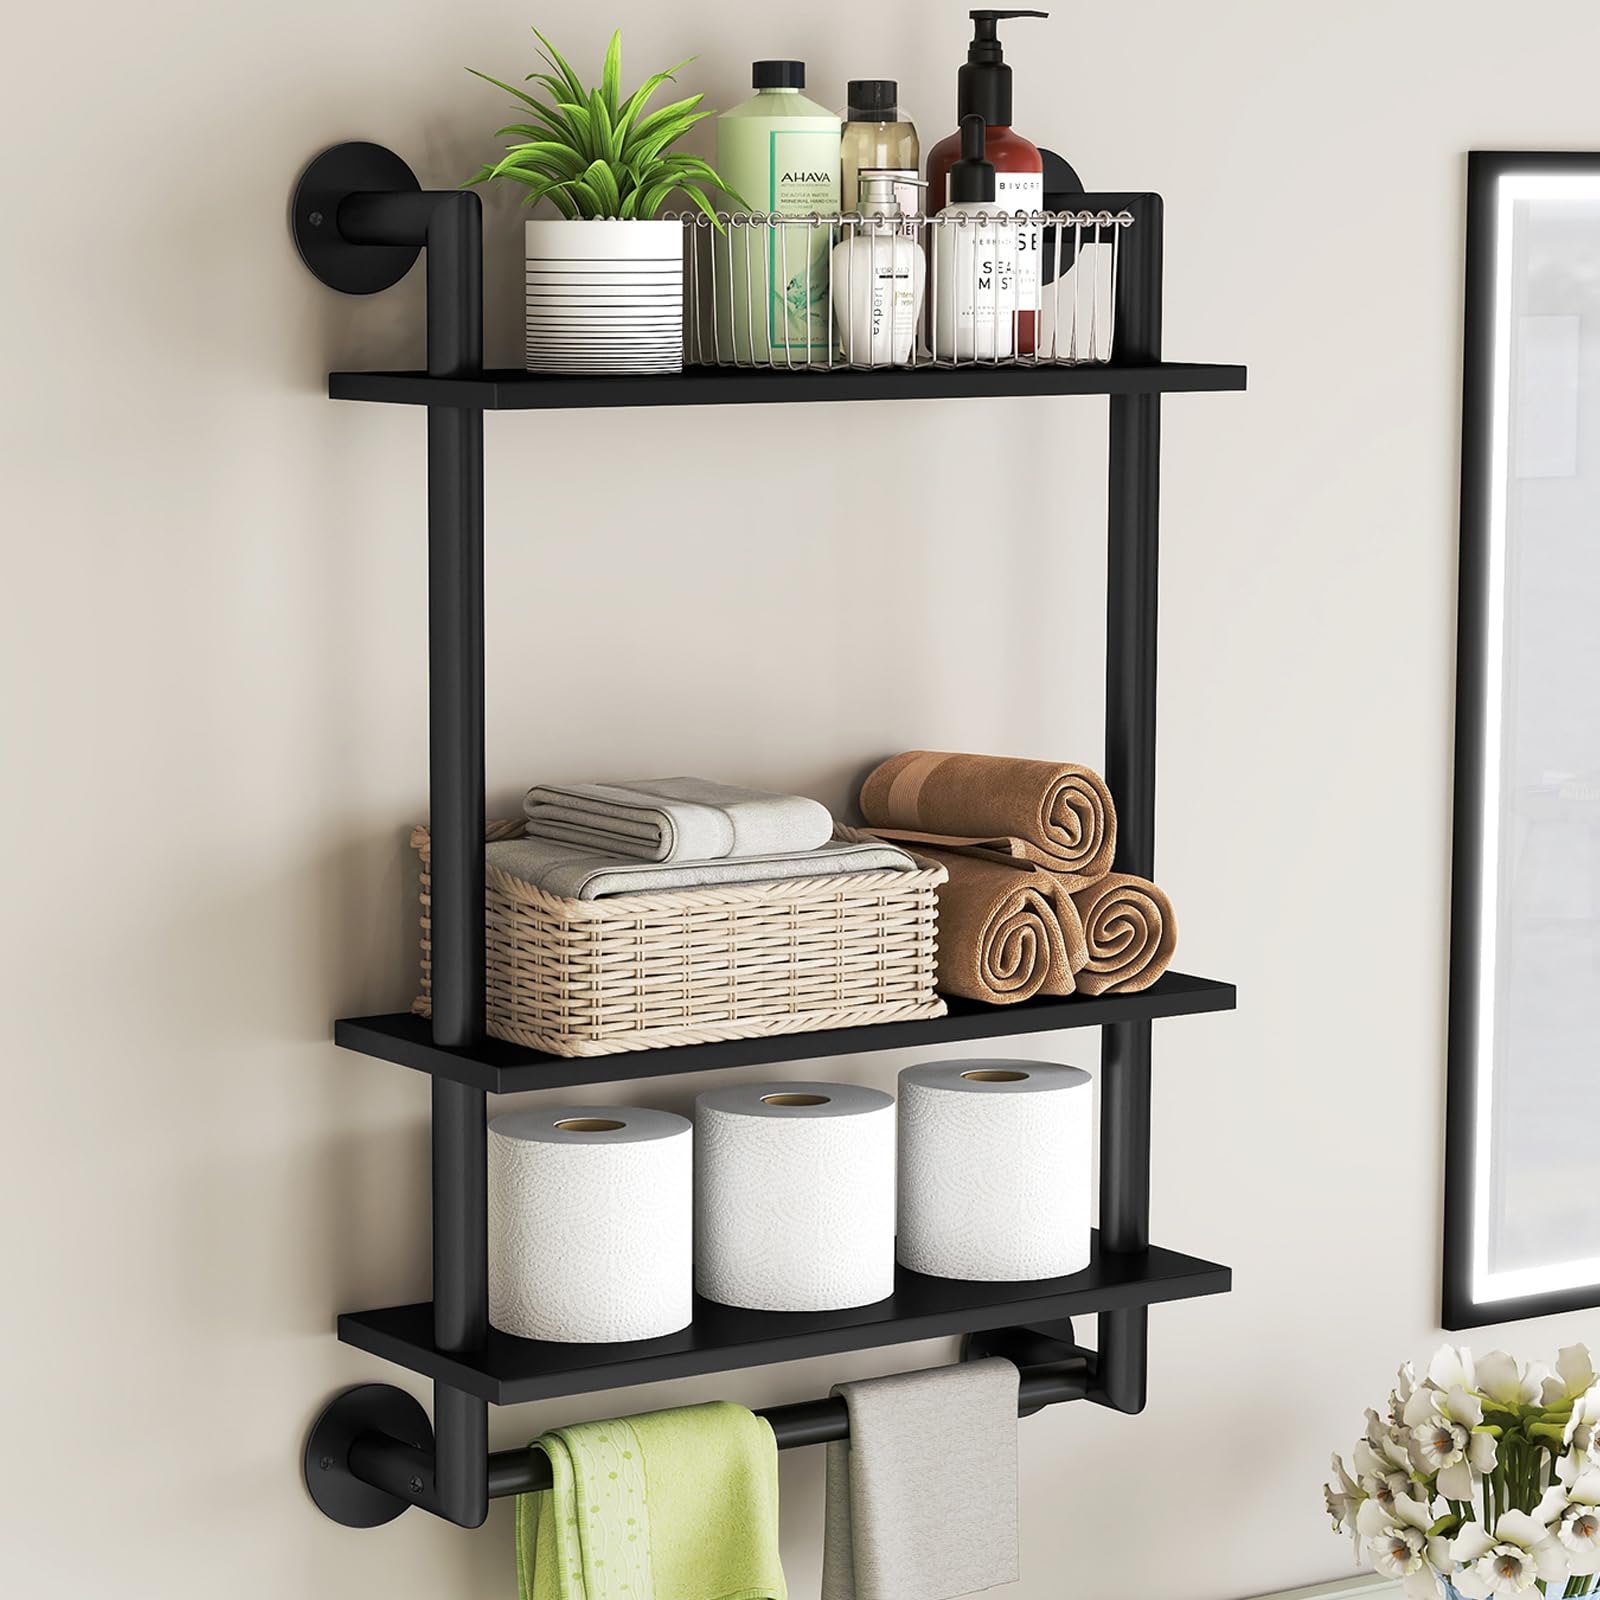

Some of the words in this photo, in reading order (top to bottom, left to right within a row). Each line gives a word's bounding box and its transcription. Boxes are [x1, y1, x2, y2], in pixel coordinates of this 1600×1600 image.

[781, 172, 831, 183] AHAVA
[982, 261, 1012, 274] SEA
[978, 277, 1013, 290] MST
